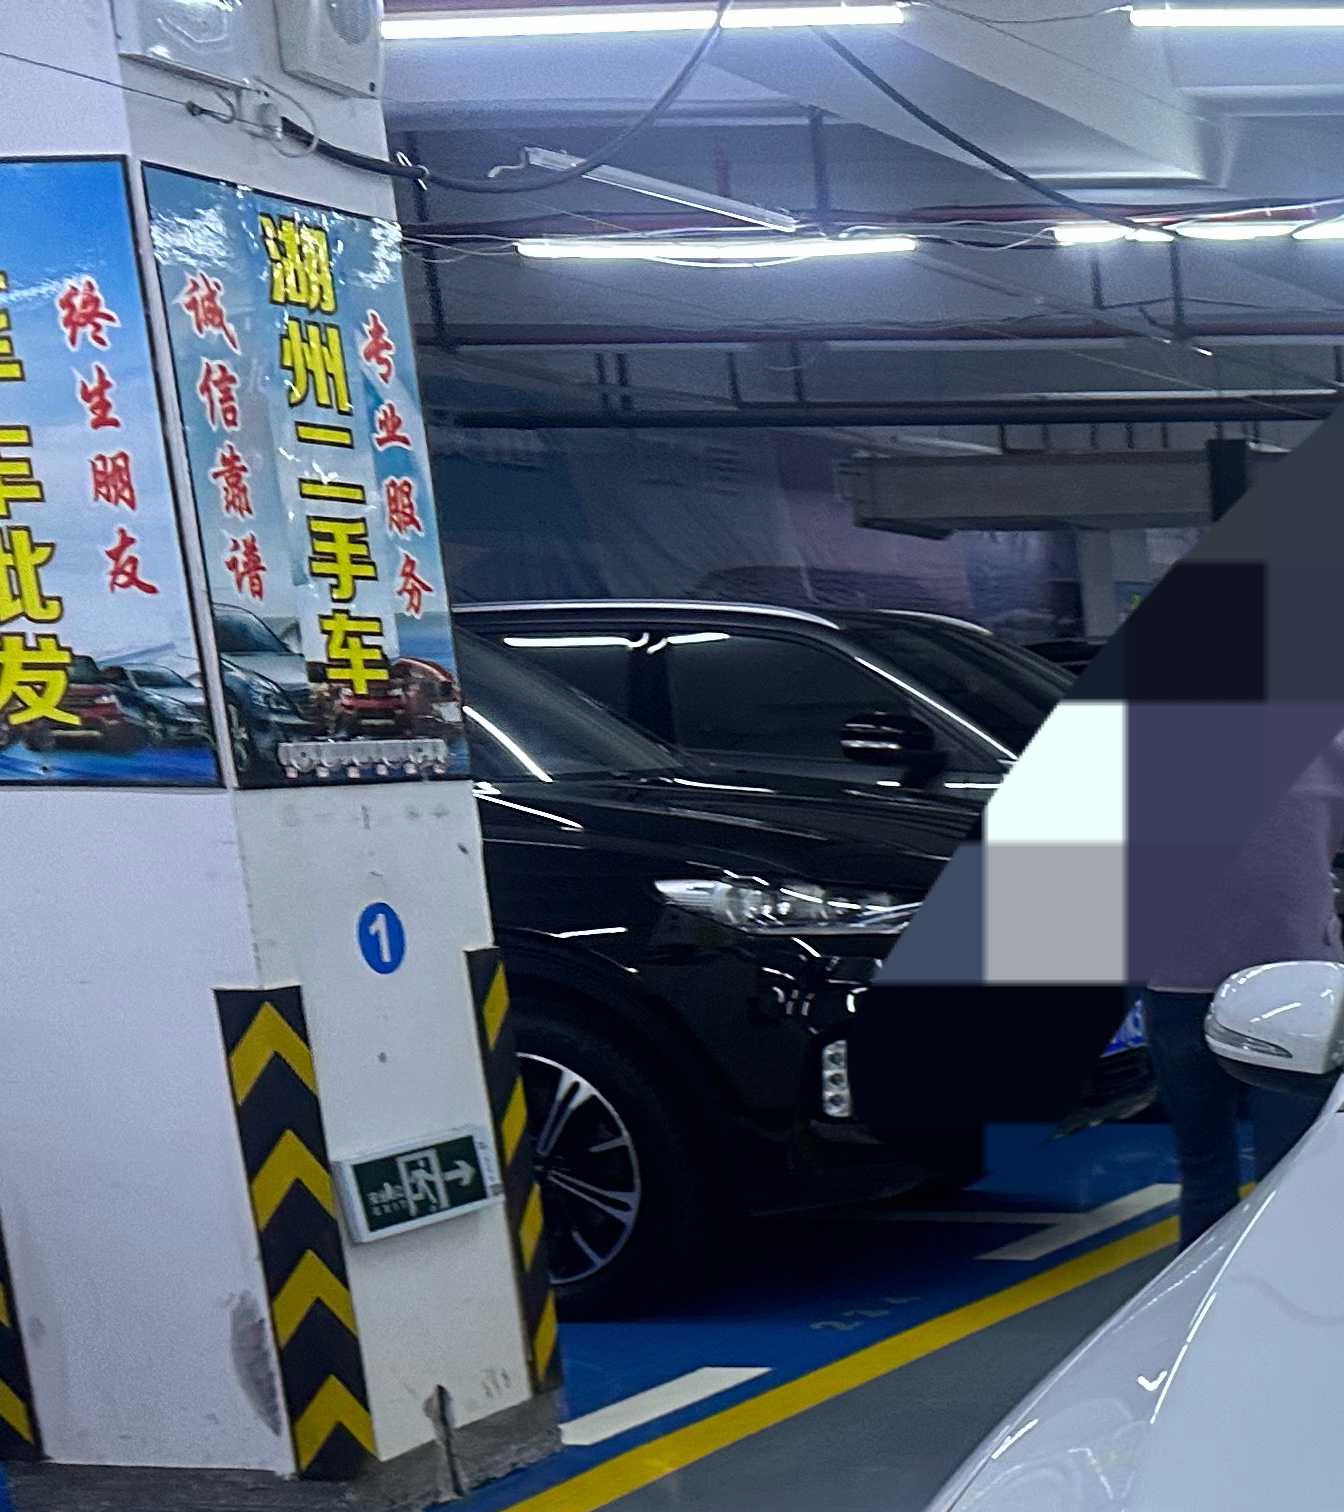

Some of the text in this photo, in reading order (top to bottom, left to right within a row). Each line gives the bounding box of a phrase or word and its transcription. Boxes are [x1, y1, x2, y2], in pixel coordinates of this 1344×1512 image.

[57, 275, 159, 595] 终生朋友
[181, 272, 266, 600] 诚信靠谱
[259, 212, 392, 697] 湖州二手车
[361, 310, 433, 617] 专业服务
[368, 913, 391, 963] 1
